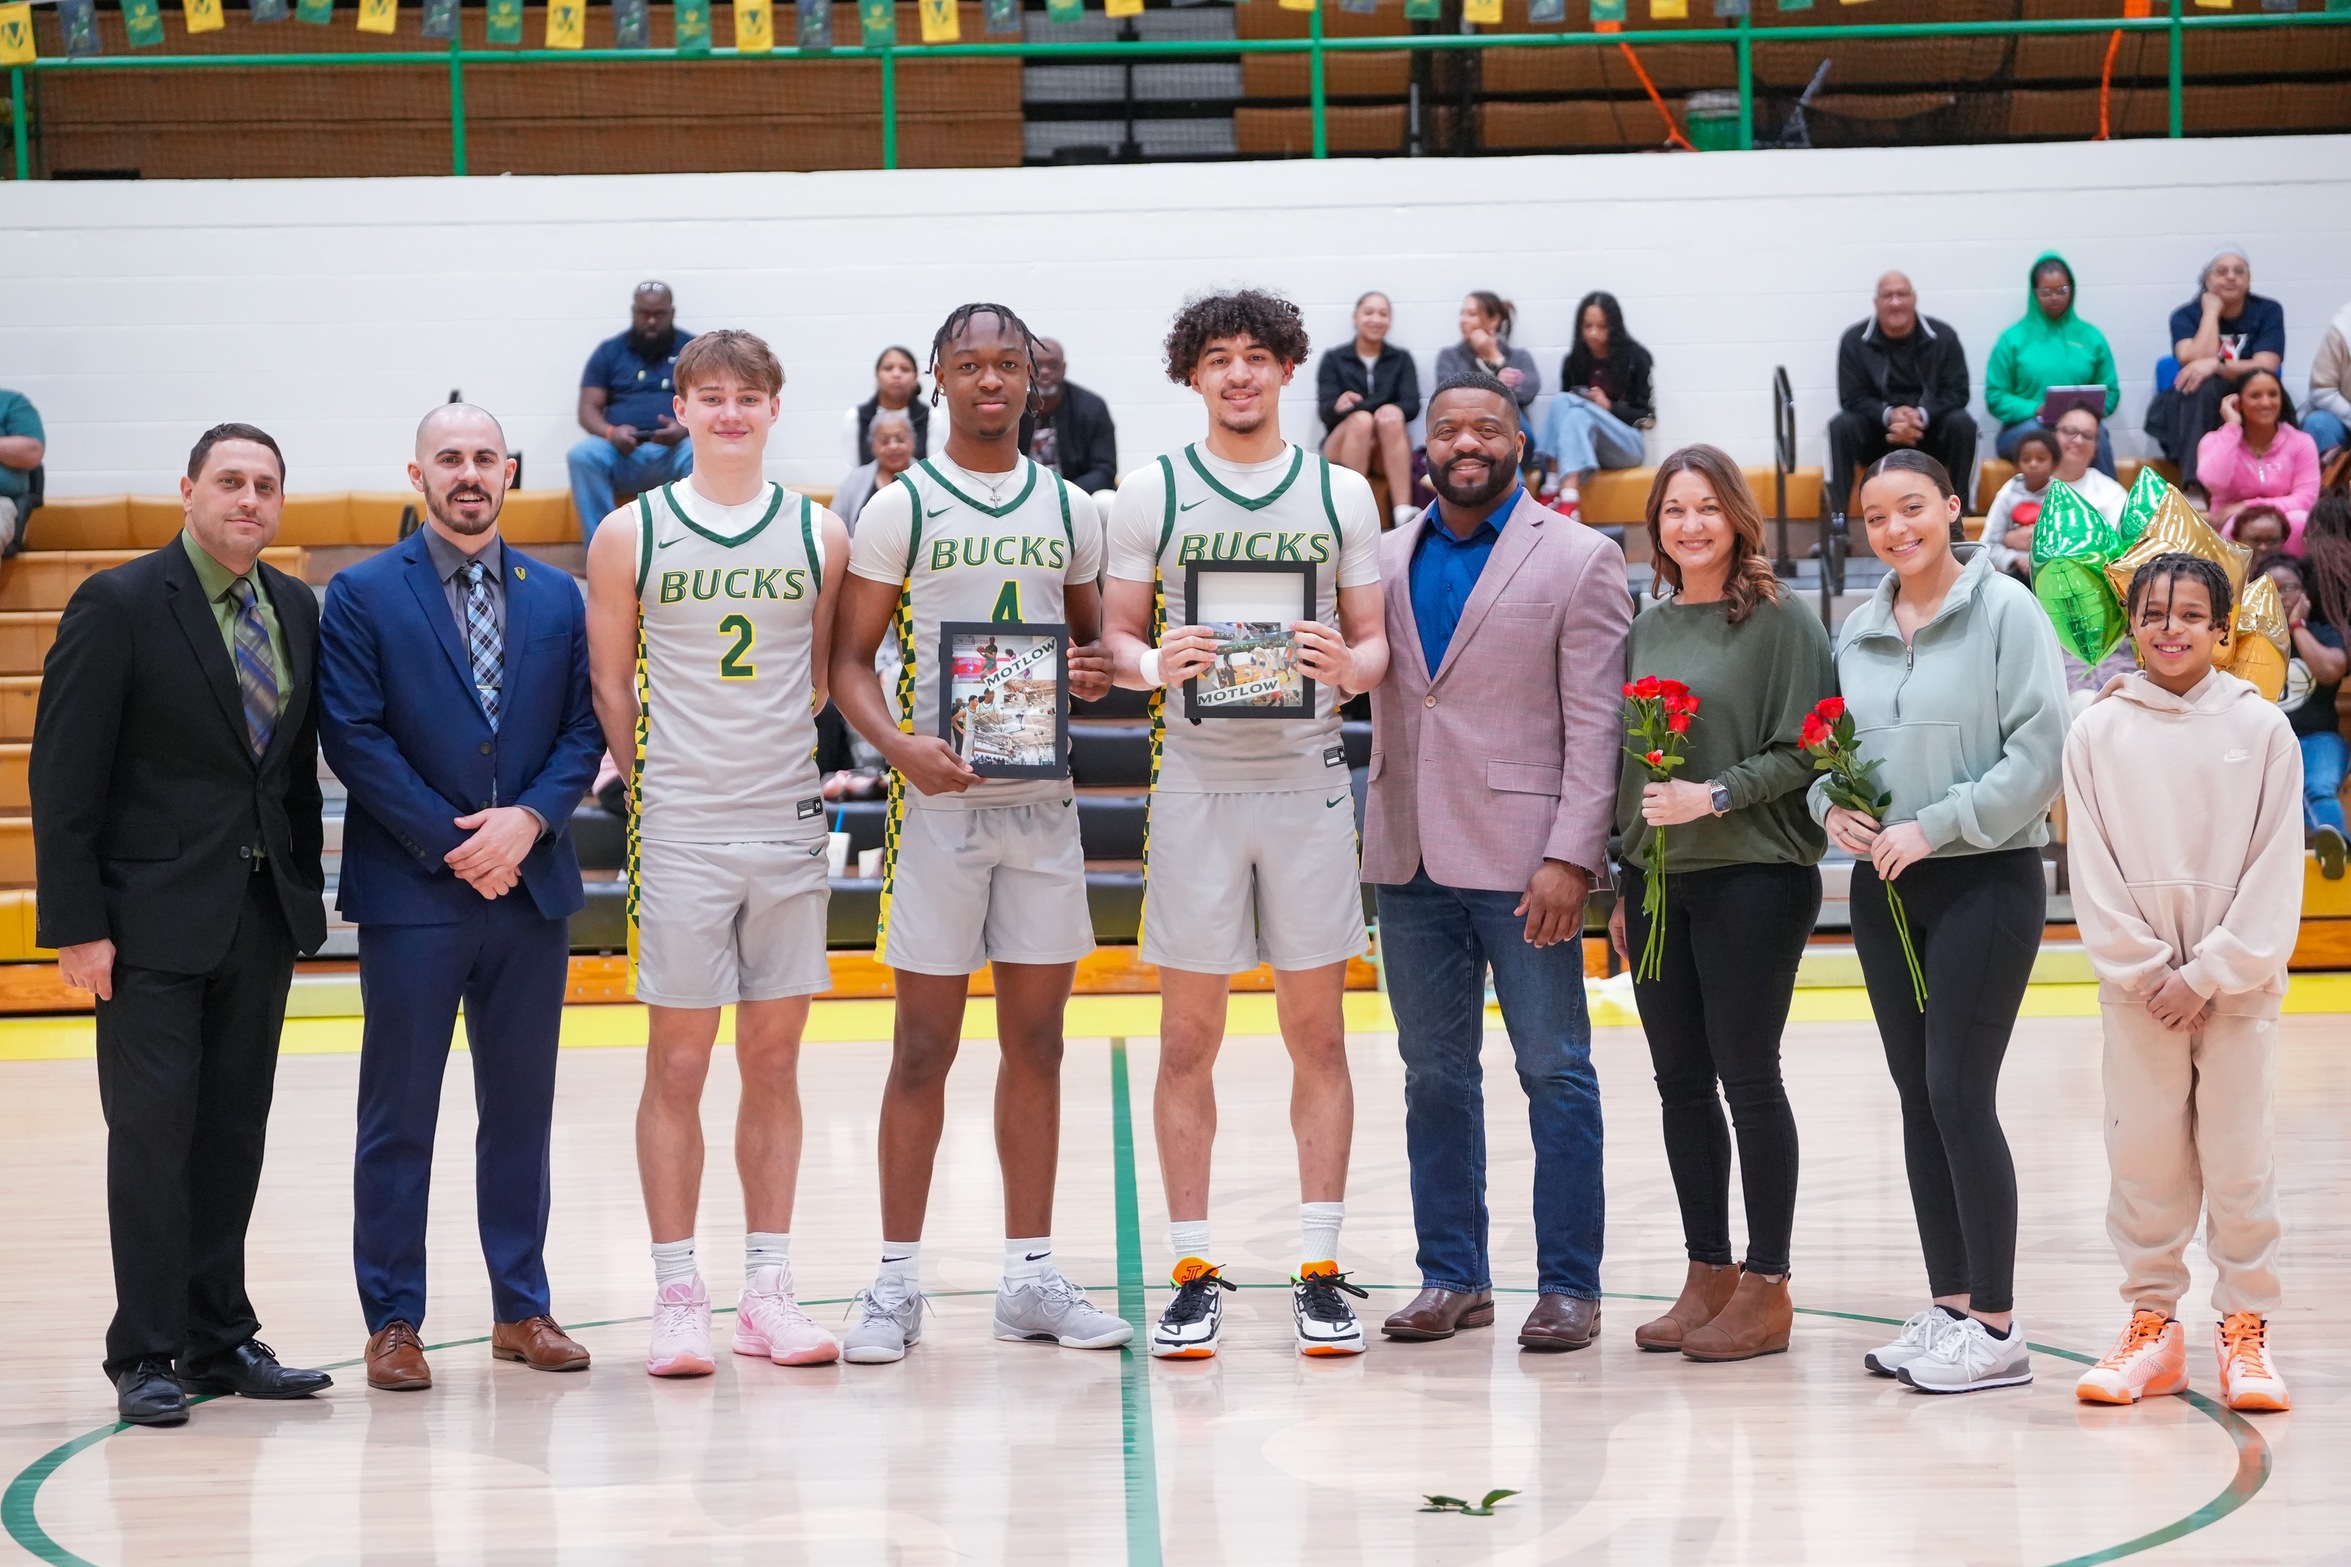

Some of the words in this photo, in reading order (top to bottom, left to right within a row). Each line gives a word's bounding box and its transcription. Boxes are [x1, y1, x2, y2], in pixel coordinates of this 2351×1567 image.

[930, 536, 1066, 571] BUCKS
[1177, 531, 1331, 567] BUCKS
[659, 568, 806, 604] BUCKS
[991, 579, 1026, 624] 4
[718, 612, 757, 681] 2
[986, 639, 1056, 687] MOTLOW
[1198, 680, 1278, 705] MOTLOW
